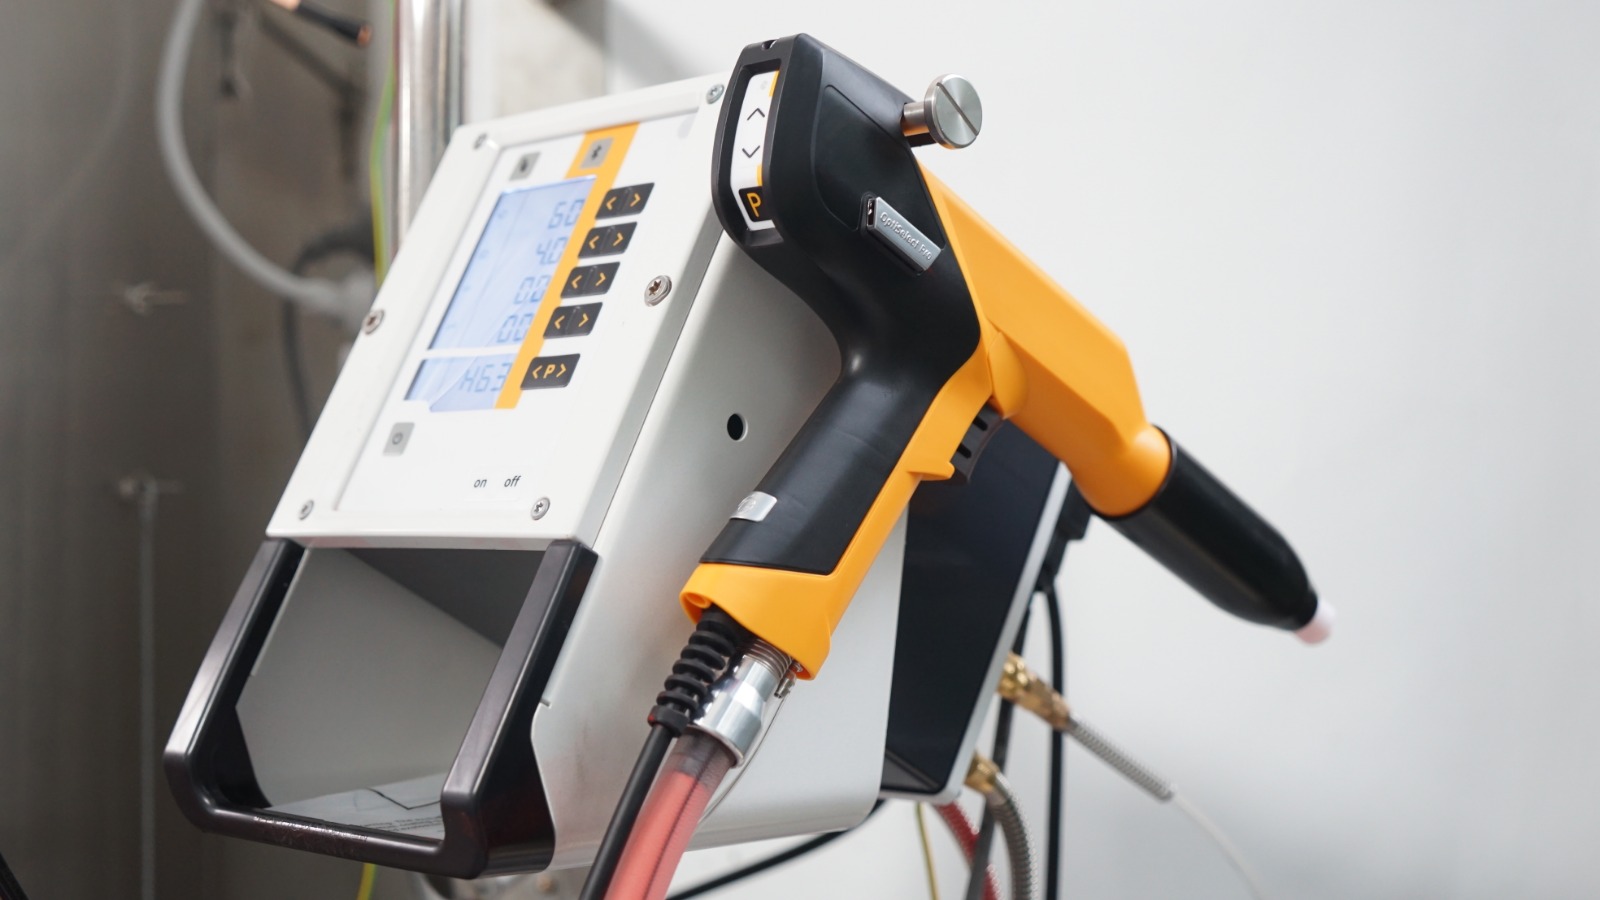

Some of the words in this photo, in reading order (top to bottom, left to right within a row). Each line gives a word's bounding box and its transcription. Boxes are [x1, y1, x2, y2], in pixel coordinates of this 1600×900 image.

[548, 198, 585, 229] 60
[746, 192, 761, 217] P
[880, 211, 919, 248] OptiSelect
[919, 243, 933, 260] Pro
[473, 479, 488, 488] on
[503, 475, 521, 488] off
